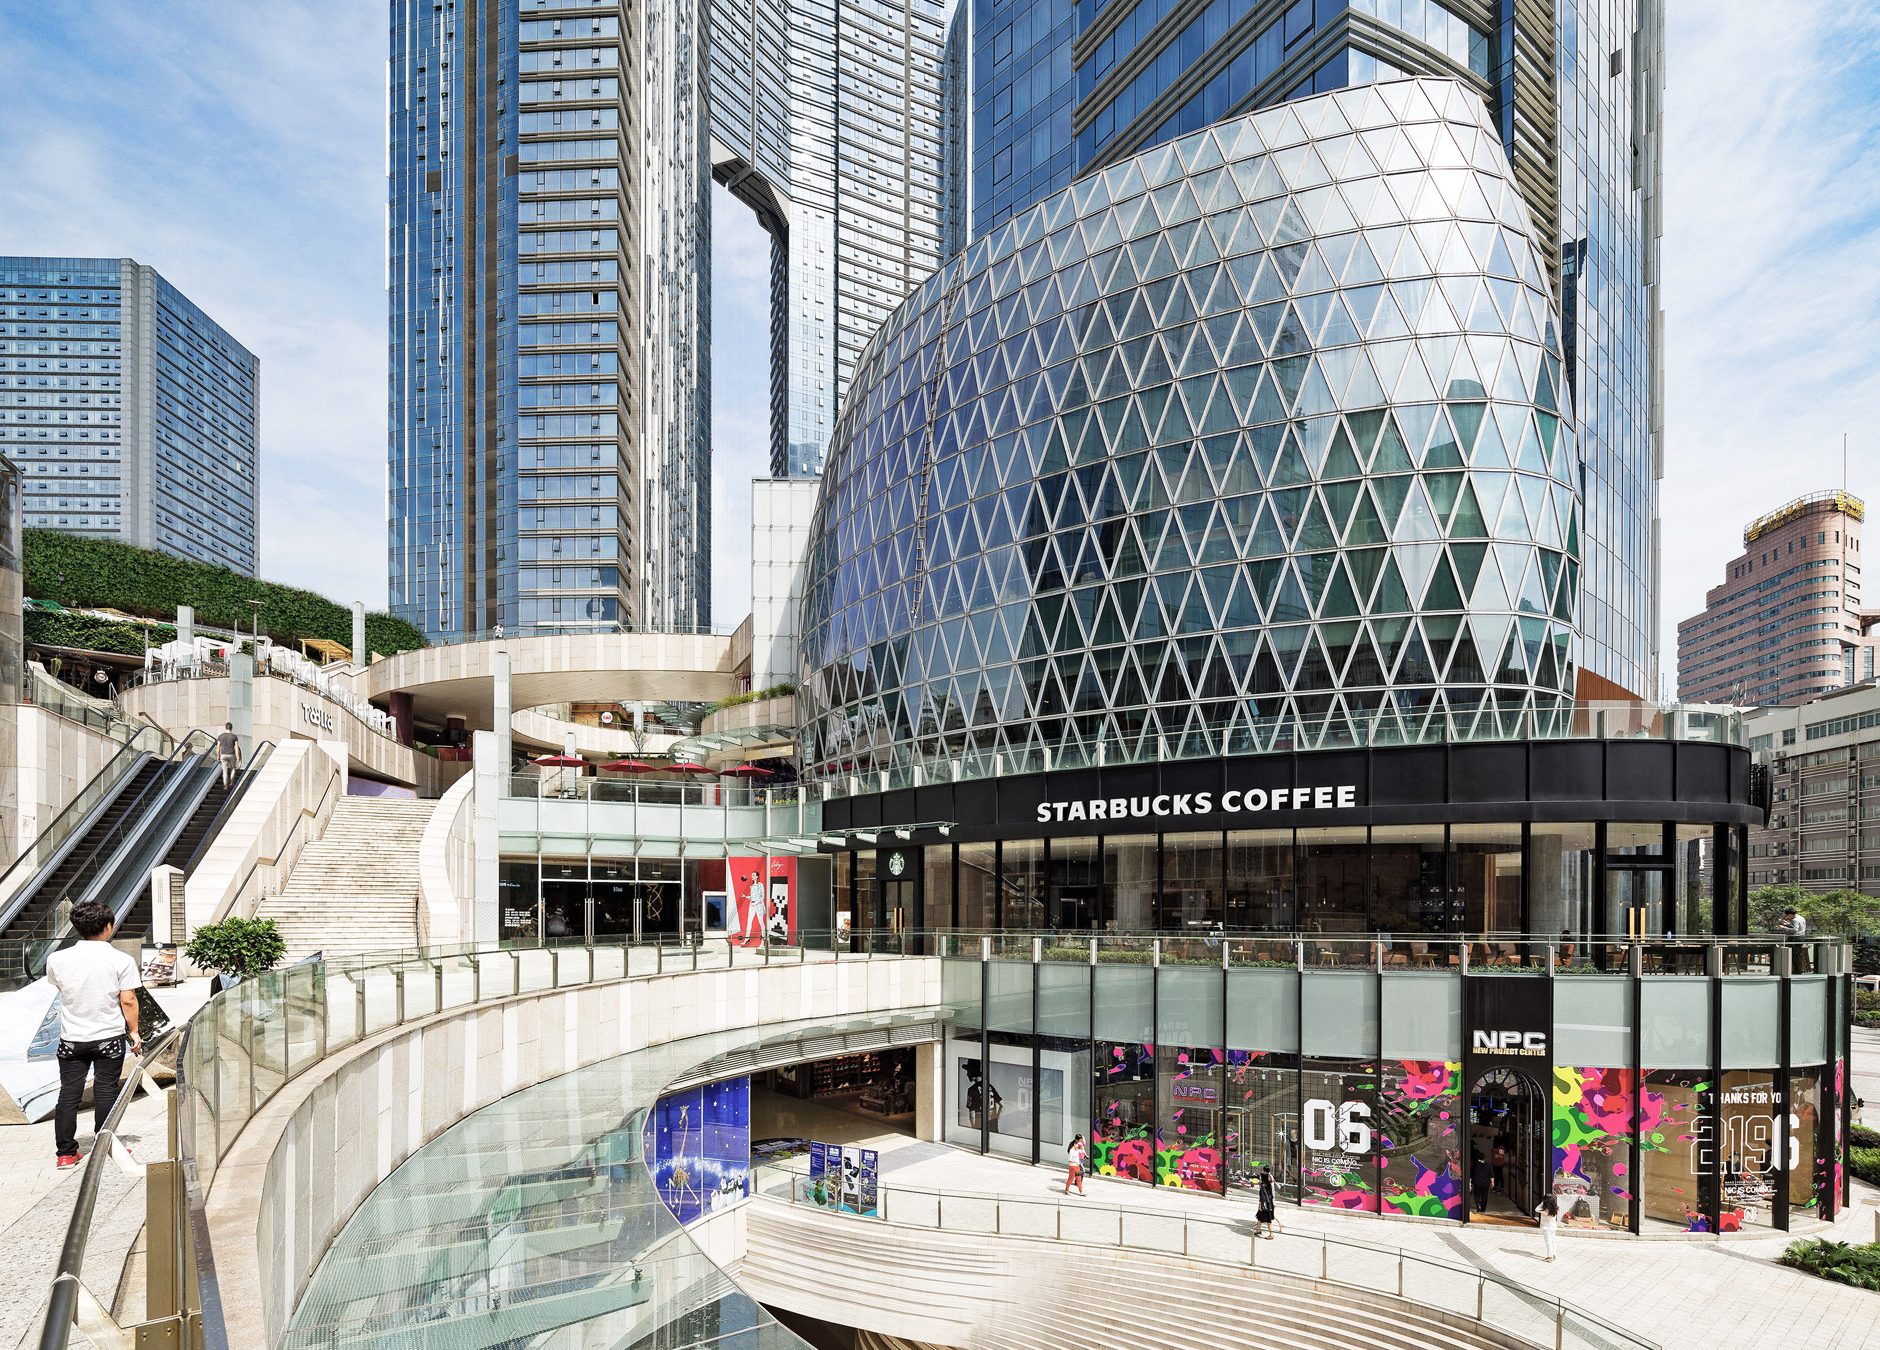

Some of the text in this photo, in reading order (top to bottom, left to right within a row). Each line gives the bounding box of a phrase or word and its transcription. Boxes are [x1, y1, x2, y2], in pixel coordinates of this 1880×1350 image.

[1037, 785, 1356, 823] STARBUCKS COFFEE
[1473, 1029, 1547, 1050] NPC
[1489, 1048, 1519, 1056] PROJECT
[1519, 1048, 1546, 1056] CENTER
[1174, 1085, 1216, 1099] NPC
[1751, 1092, 1768, 1104] FOR
[1770, 1092, 1782, 1103] YO
[1304, 1099, 1371, 1154] 06
